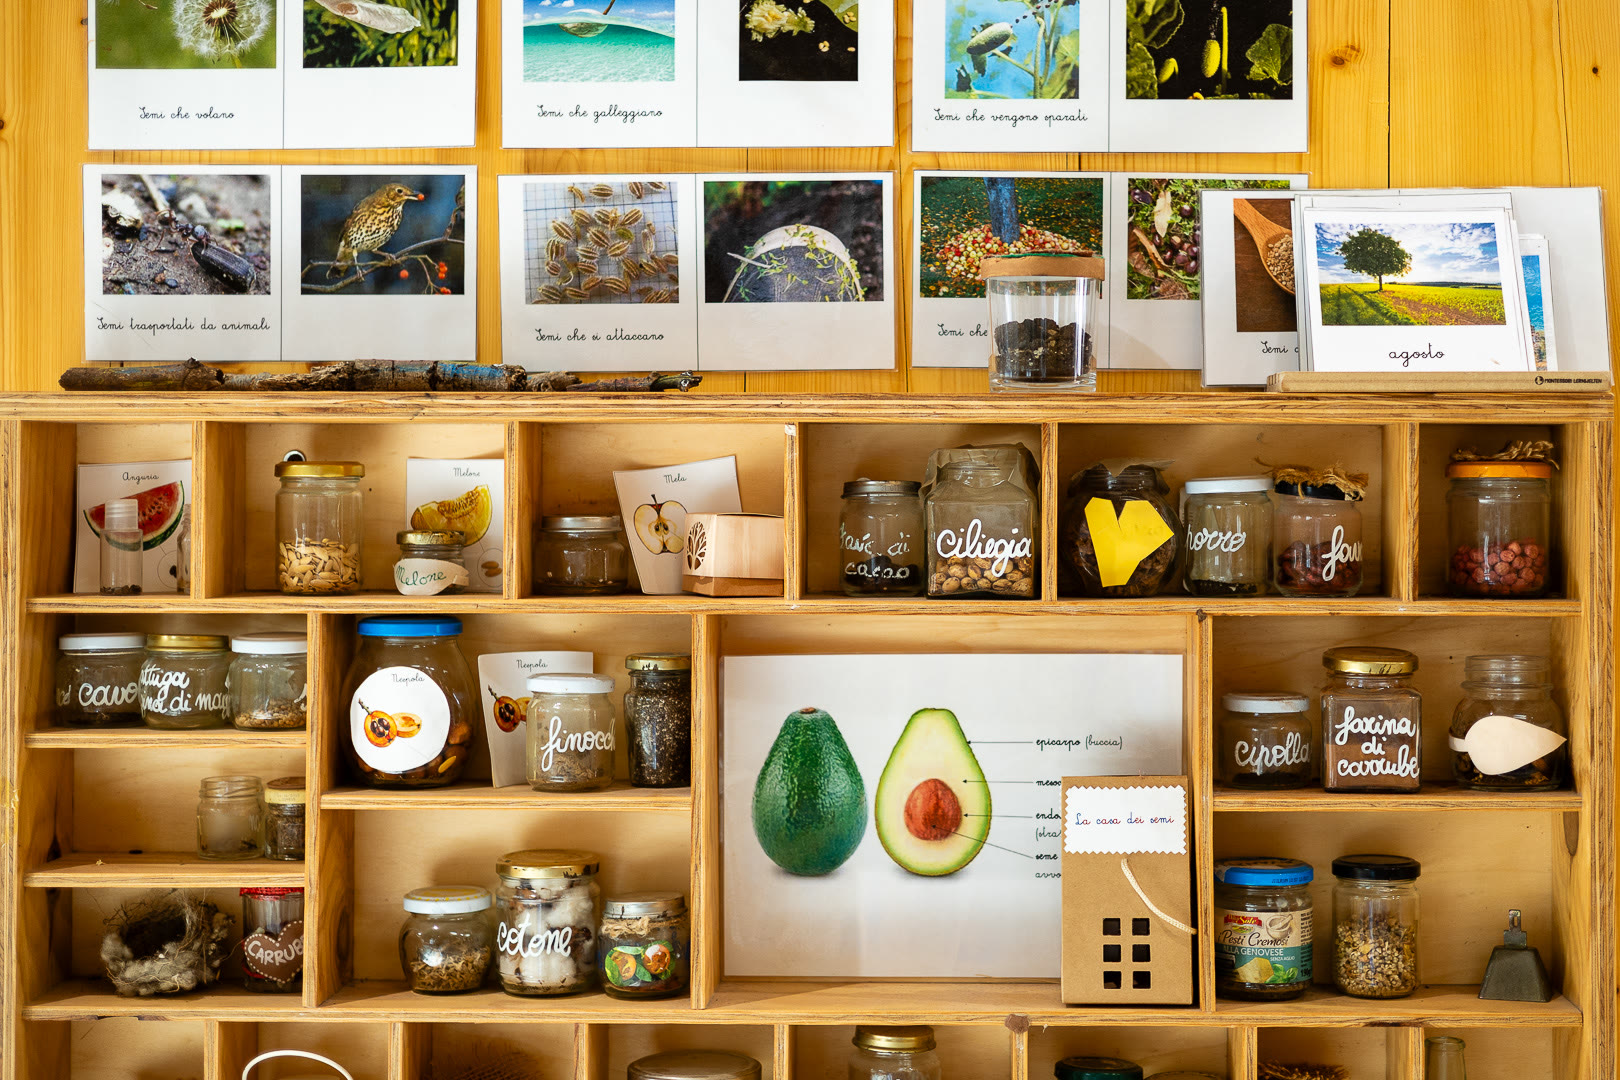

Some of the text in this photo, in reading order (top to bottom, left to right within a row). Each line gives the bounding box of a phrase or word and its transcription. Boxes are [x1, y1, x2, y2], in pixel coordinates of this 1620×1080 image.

[138, 106, 235, 119] Semi che volano
[537, 104, 663, 124] Semi che galleggiano
[933, 108, 1089, 127] Semi che vengono sparati
[96, 317, 271, 336] Semi trasportati da animali
[937, 323, 988, 337] Semi che
[534, 328, 665, 341] Semi che si attaccano
[1260, 340, 1289, 353] Semi
[1388, 342, 1445, 367] agosto
[122, 471, 160, 485] Anguria
[453, 467, 481, 477] Melone
[663, 472, 688, 484] Mela
[395, 564, 447, 586] Melone
[516, 659, 549, 673] Nespola
[391, 672, 425, 686] Nespola
[1036, 734, 1123, 751] epicarpo (buccia)
[1360, 735, 1387, 756] di
[1036, 779, 1062, 787] mesoc
[1075, 812, 1091, 826] La
[1126, 811, 1145, 824] dei
[1149, 815, 1175, 824] semi
[1035, 853, 1059, 861] seme
[1222, 929, 1247, 946] Pesti
[1248, 931, 1290, 948] Cremosi
[247, 938, 304, 966] CARRUB
[1240, 947, 1284, 957] GENOVESE
